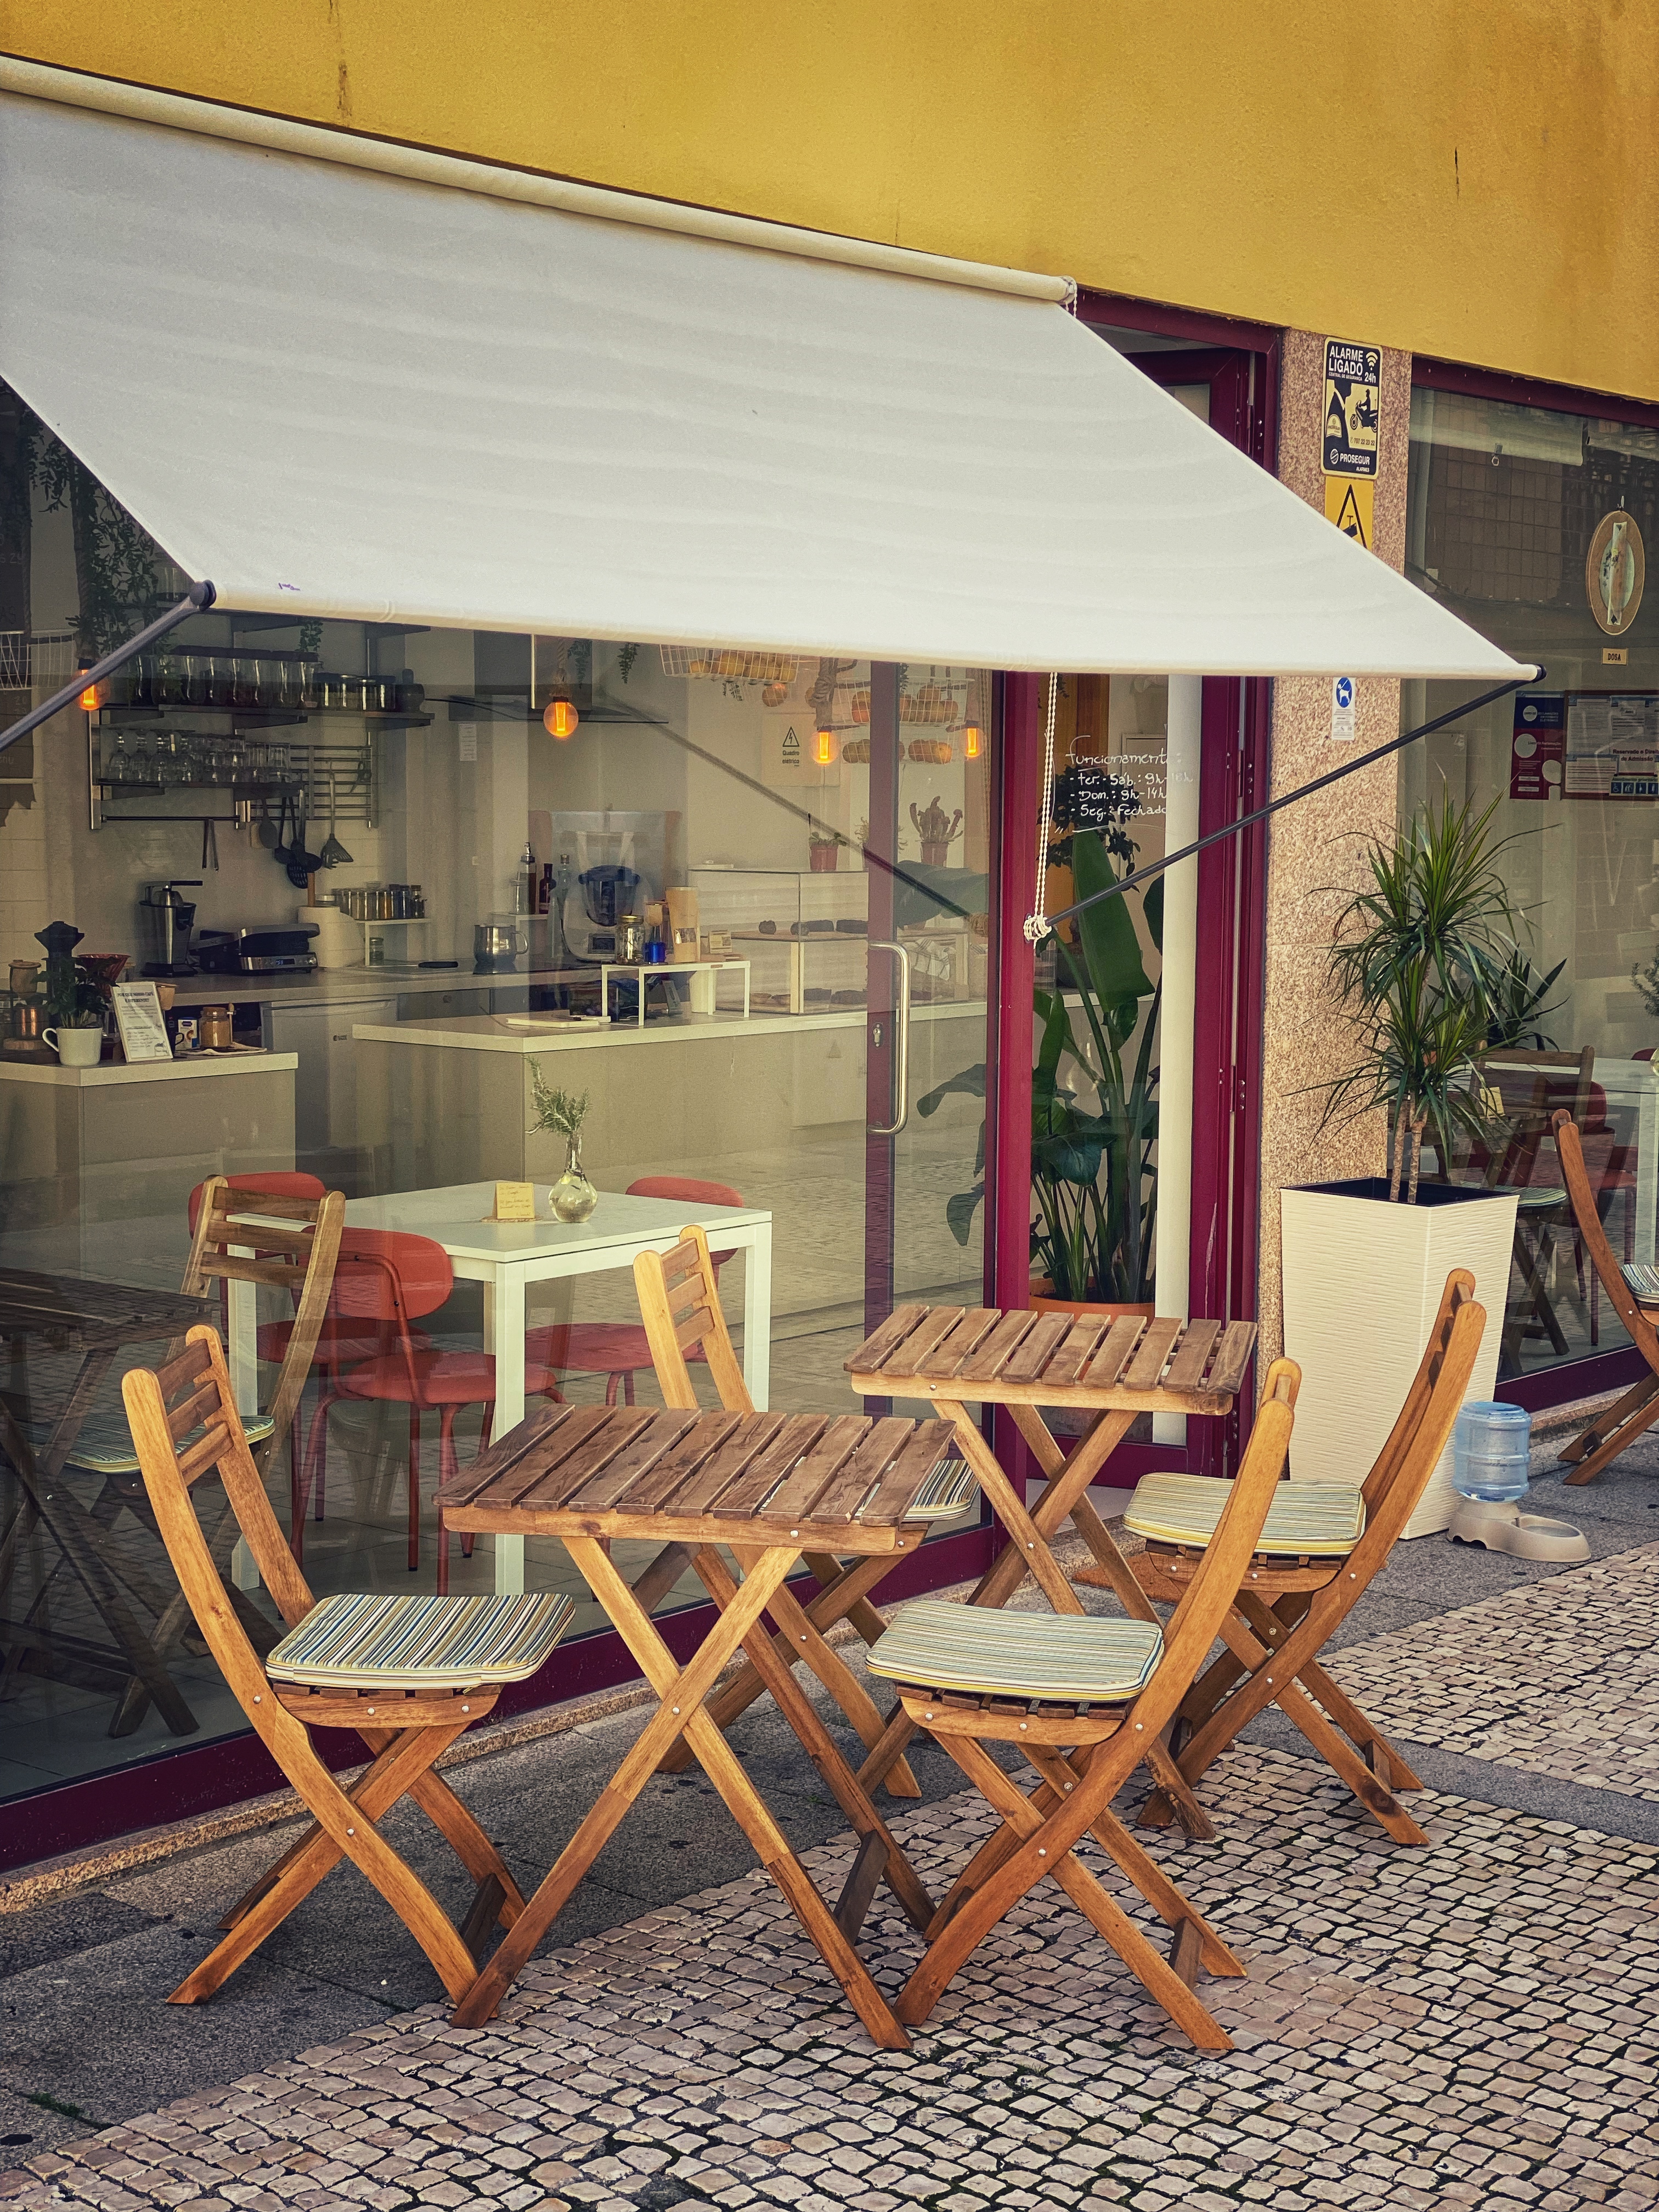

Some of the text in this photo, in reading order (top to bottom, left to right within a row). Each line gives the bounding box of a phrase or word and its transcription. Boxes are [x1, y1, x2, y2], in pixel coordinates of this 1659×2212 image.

[1329, 345, 1364, 362] ALARME
[1329, 358, 1363, 376] LIGADO
[1364, 371, 1376, 383] 24h
[1340, 453, 1370, 466] PROSEGUR
[1607, 653, 1622, 662] DOSA
[1065, 735, 1182, 766] Funcionament:
